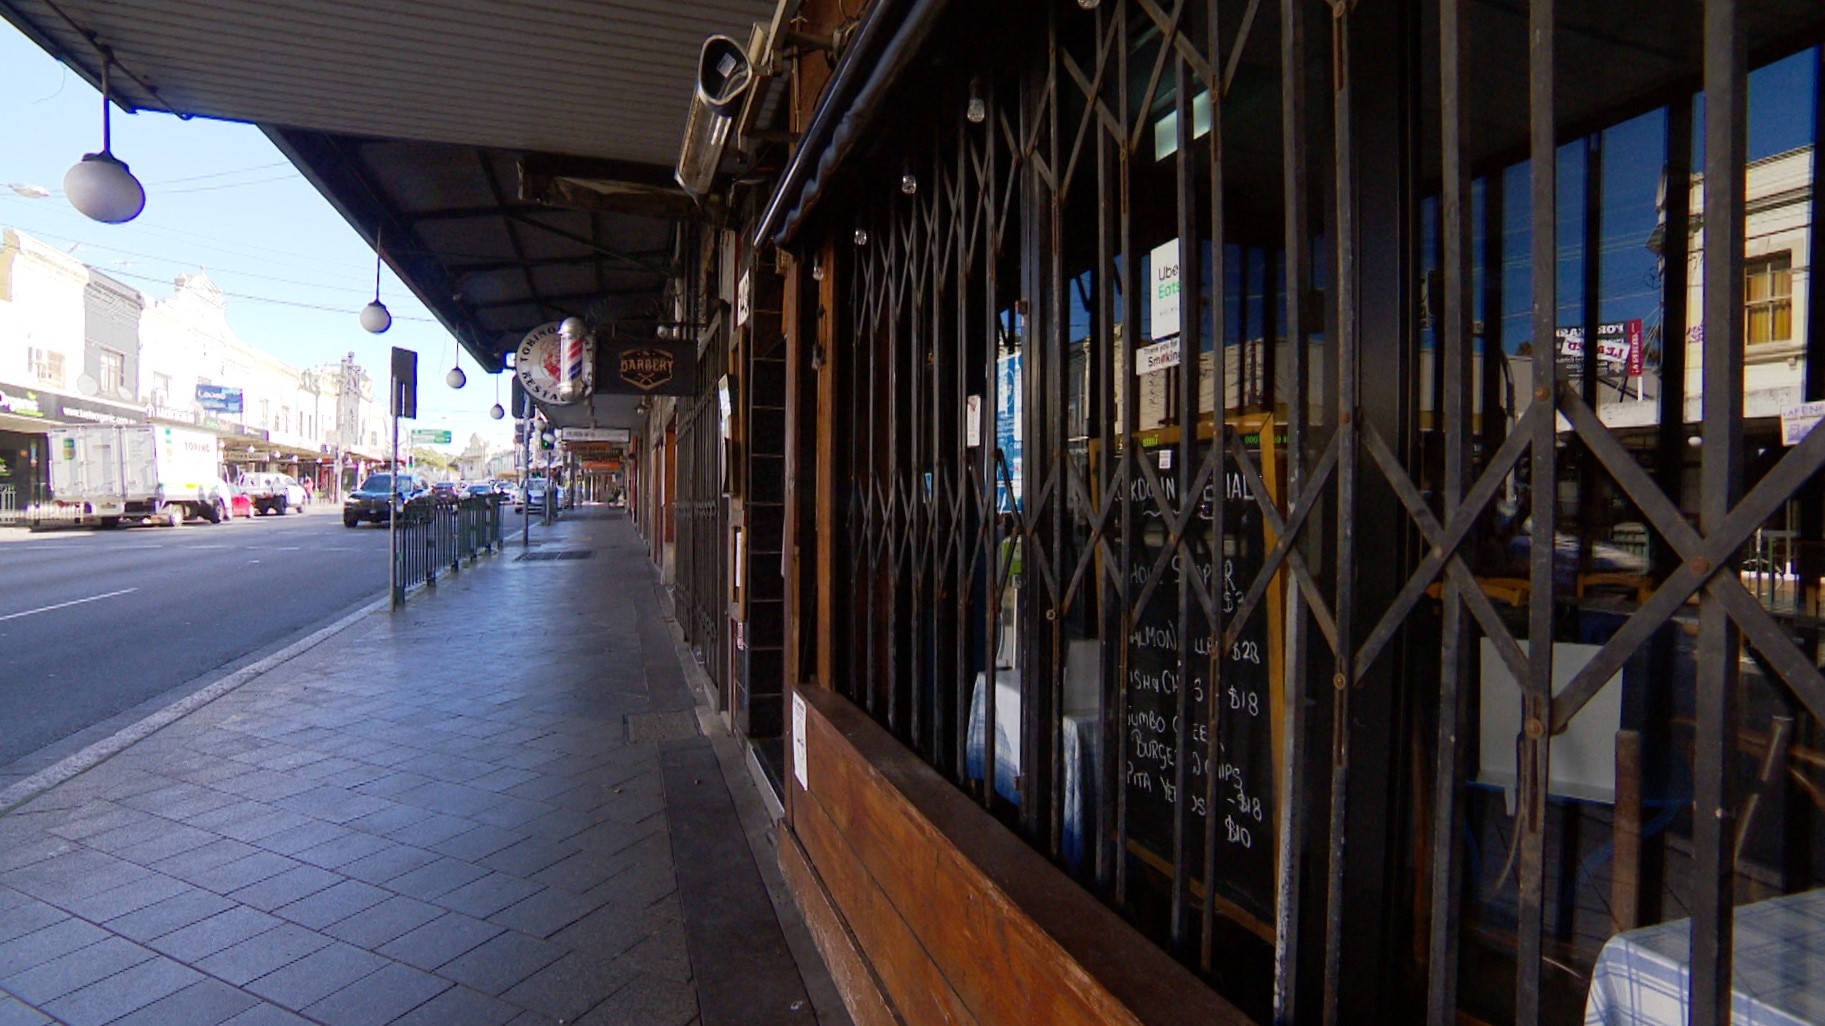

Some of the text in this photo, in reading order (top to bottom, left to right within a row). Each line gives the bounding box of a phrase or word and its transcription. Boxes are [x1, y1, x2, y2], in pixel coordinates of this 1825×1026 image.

[1158, 264, 1179, 281] Ube
[1227, 685, 1259, 717] $18
[1129, 728, 1177, 770] BURGE
[1225, 814, 1251, 849] $10
